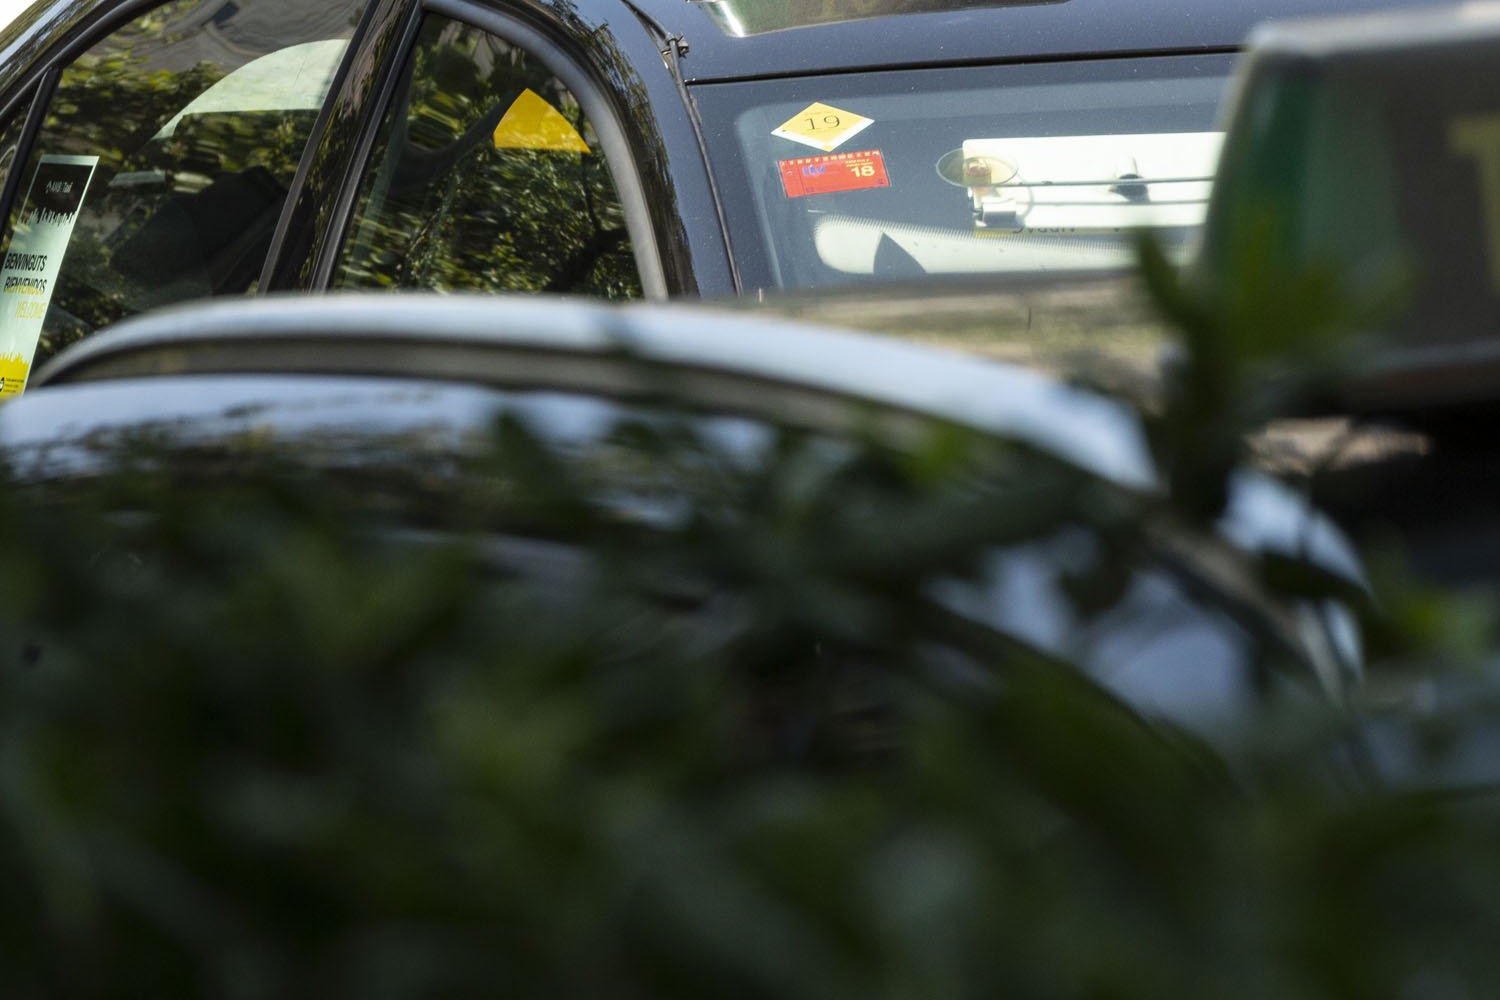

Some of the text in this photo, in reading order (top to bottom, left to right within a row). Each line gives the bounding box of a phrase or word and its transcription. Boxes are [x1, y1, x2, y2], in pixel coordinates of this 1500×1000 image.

[805, 115, 840, 131] 19
[850, 166, 875, 177] 18
[4, 252, 47, 272] BENVINGUTS
